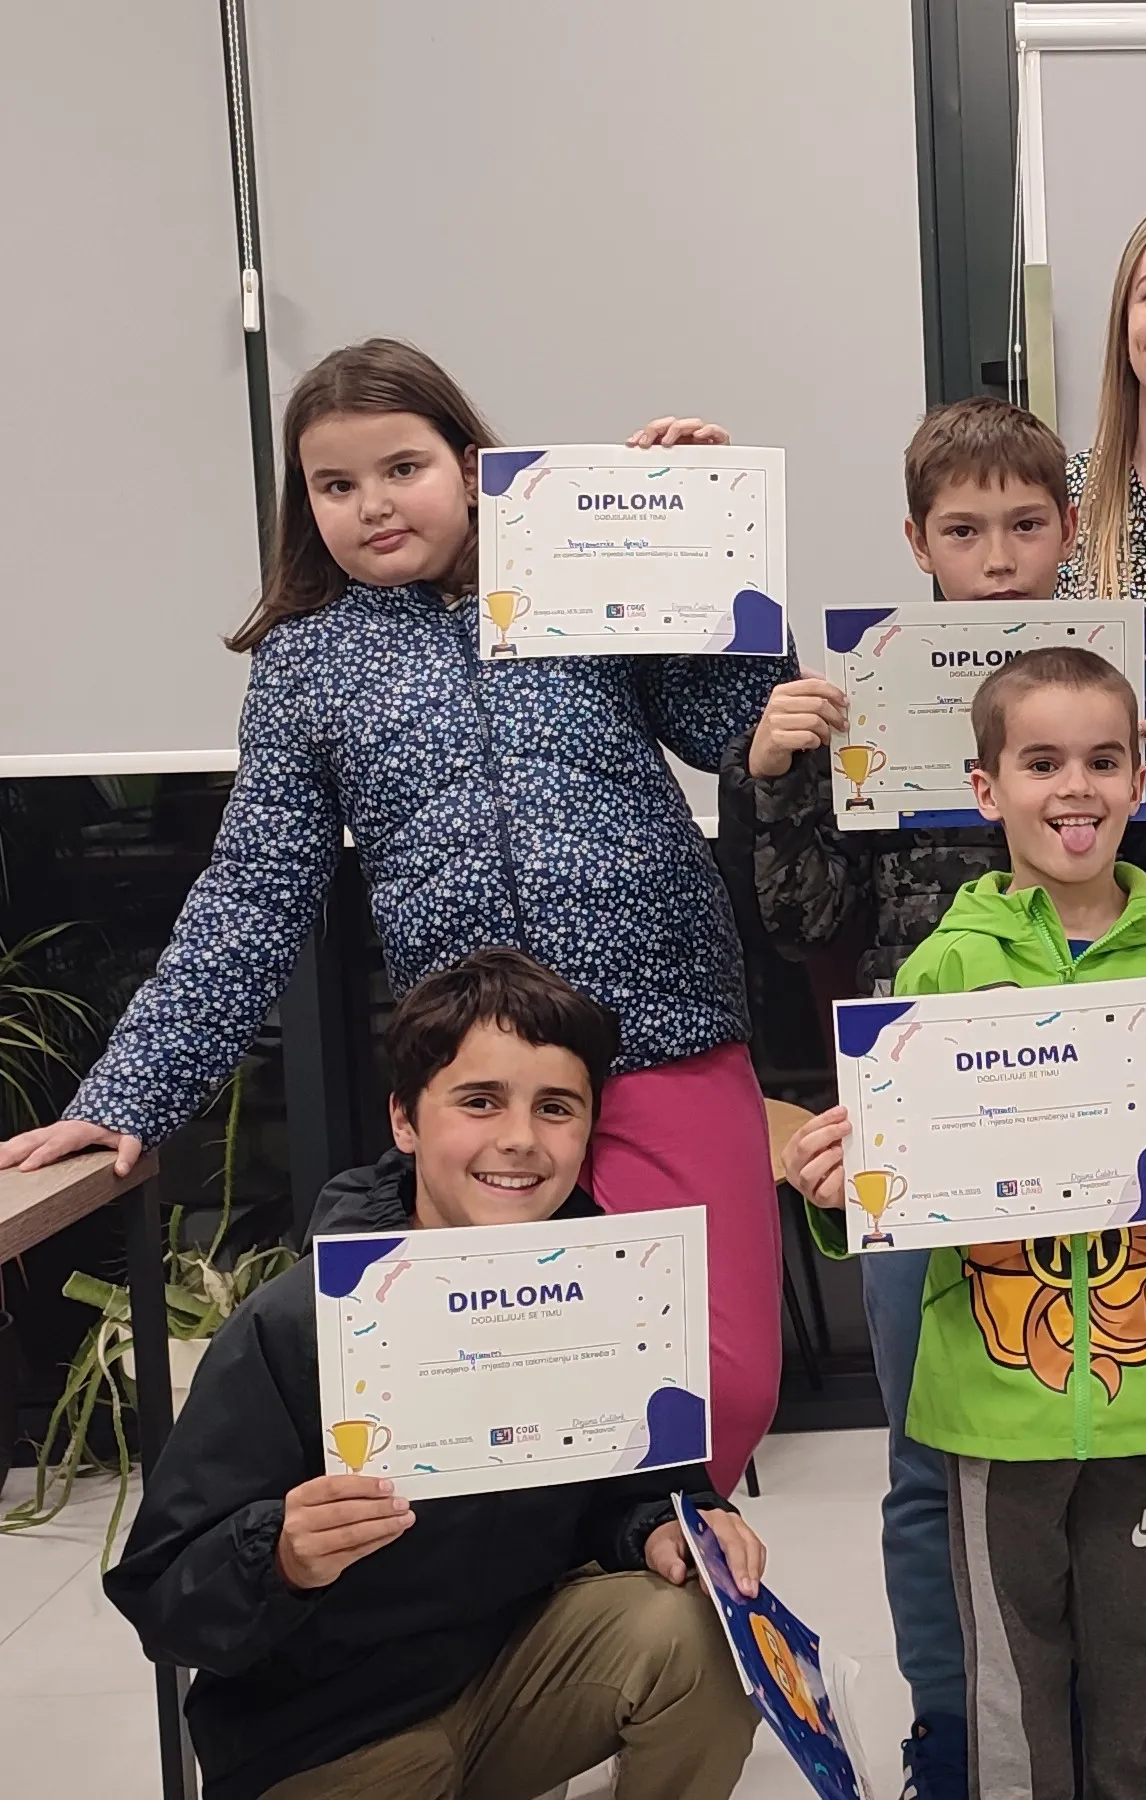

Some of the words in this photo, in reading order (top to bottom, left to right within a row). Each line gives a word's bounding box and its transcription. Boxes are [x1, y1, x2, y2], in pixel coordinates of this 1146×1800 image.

[577, 493, 684, 511] DIPLOMA
[931, 650, 1022, 667] DIPLOM
[956, 1043, 1079, 1072] DIPLOMA
[1020, 1178, 1041, 1187] CODE
[1021, 1186, 1043, 1195] LAND
[448, 1281, 584, 1313] DIPLOMA
[471, 1313, 526, 1325] DODJELJUJE
[528, 1311, 538, 1319] SE
[541, 1309, 562, 1318] TIMU
[515, 1424, 539, 1434] CODE
[517, 1433, 541, 1442] LAND
